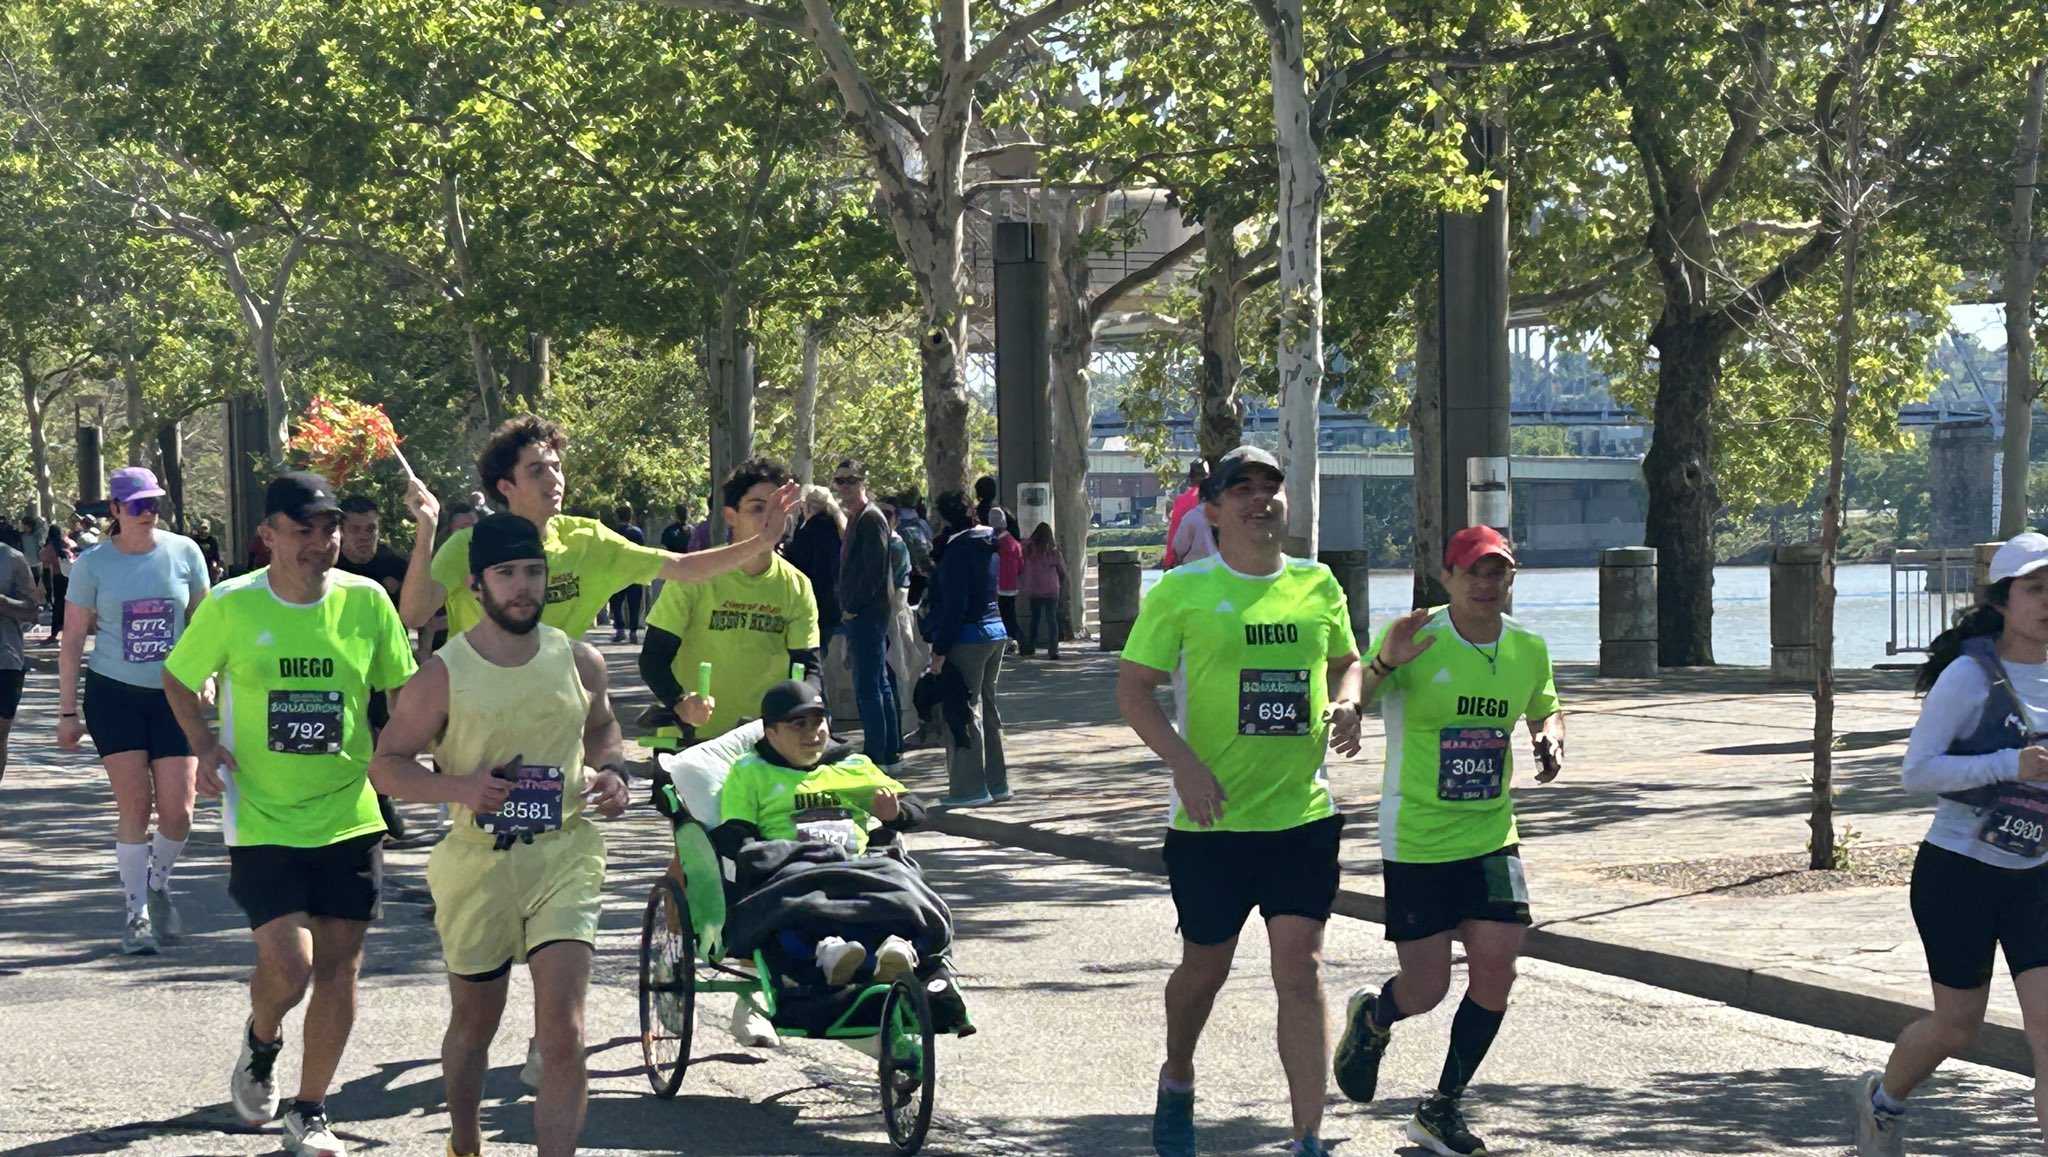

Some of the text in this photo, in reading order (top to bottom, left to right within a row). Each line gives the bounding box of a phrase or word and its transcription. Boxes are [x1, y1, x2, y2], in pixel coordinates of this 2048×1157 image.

[131, 618, 166, 631] 6772
[1245, 623, 1298, 645] DIEGO
[132, 641, 167, 653] 6772
[279, 657, 334, 678] DIEGO
[1258, 702, 1297, 720] 694
[1456, 696, 1508, 718] DIEGO
[288, 722, 325, 739] 792
[1452, 758, 1495, 775] 3041
[496, 801, 552, 819] 8581
